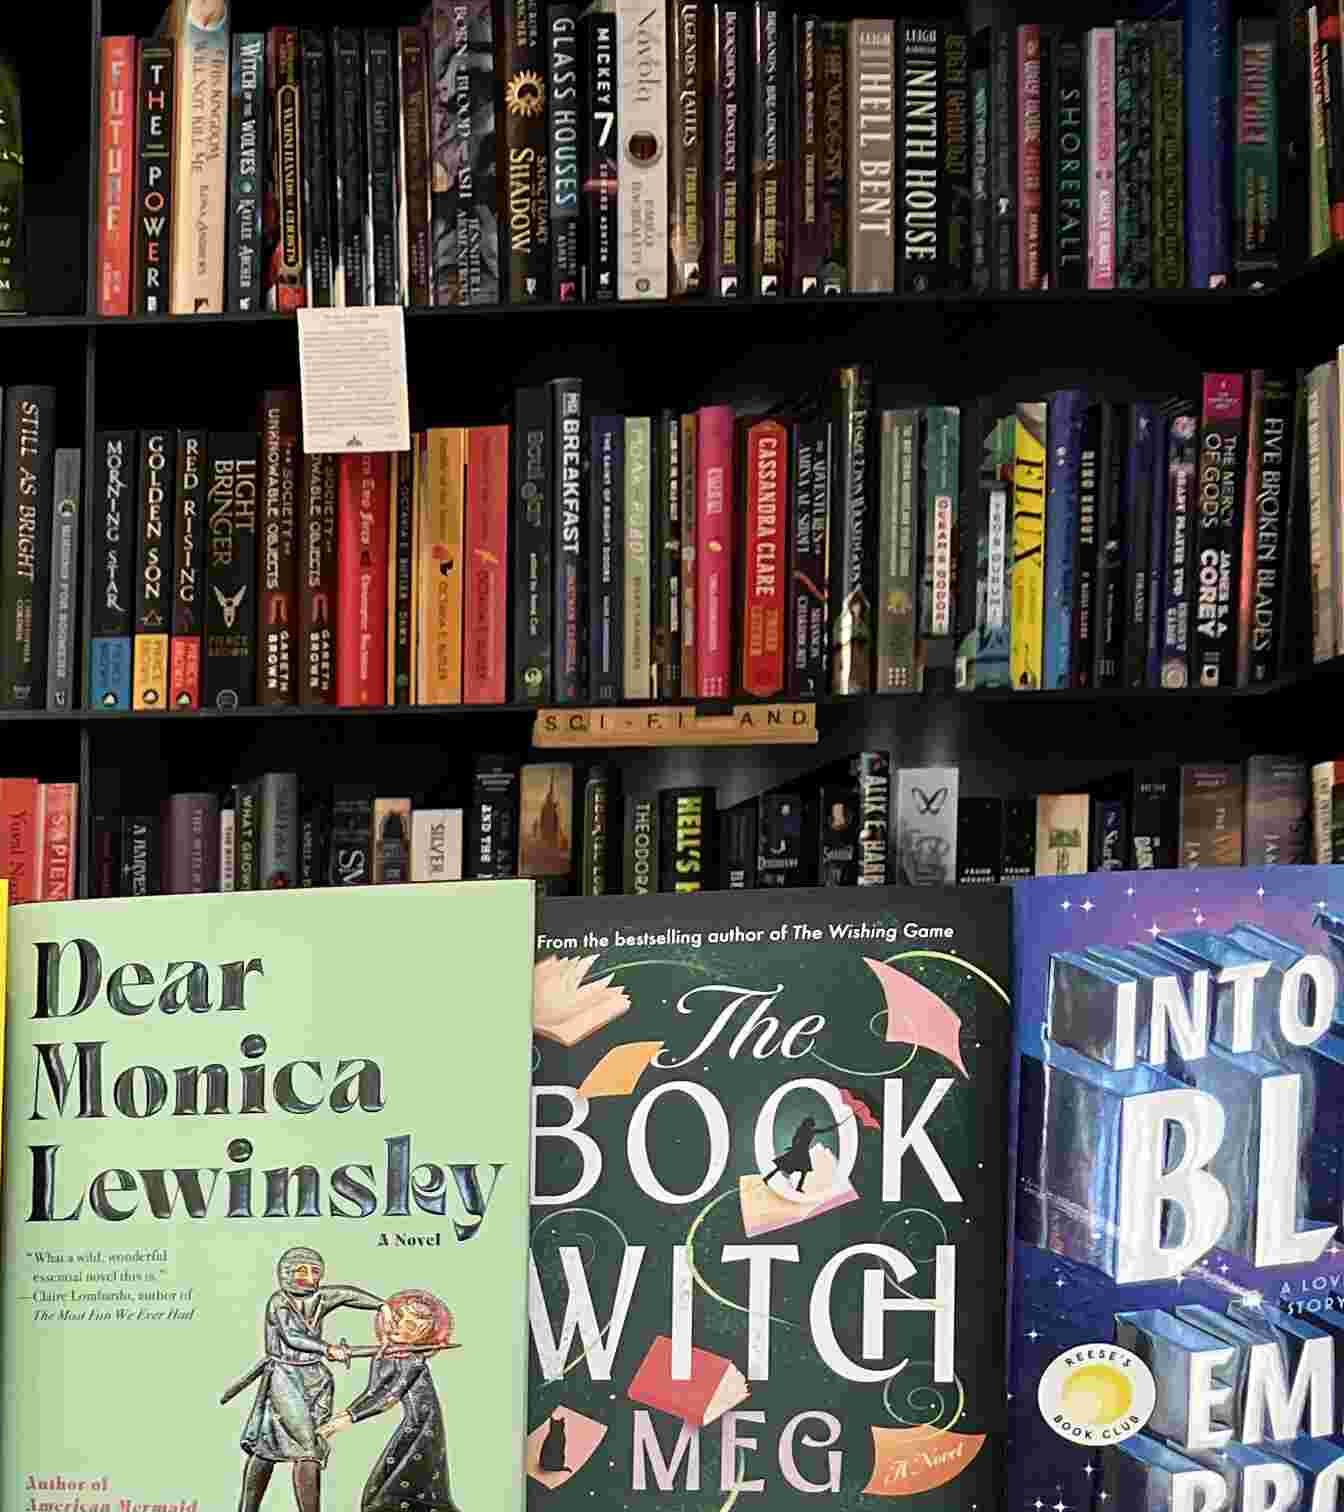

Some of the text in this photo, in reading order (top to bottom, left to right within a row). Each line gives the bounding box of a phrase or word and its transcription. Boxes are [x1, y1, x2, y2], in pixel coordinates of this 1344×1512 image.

[147, 66, 165, 136] THE
[553, 17, 577, 204] GLASS HOUSES
[594, 28, 613, 147] MICKEY 7
[510, 148, 533, 254] SHADOW
[860, 160, 892, 237] BENT
[905, 70, 936, 261] NINTH HOUSE
[1061, 88, 1081, 267] SHOREFALL
[143, 166, 165, 287] POWER
[17, 401, 39, 583] STILL BRIGHT
[106, 439, 127, 613] MORNING STAR
[145, 437, 165, 599] GOLDEN SON
[180, 439, 199, 602] RED RISING
[235, 459, 256, 528] LIGHT
[562, 419, 581, 554] BREAKFAST
[755, 436, 779, 597] CASSANDRA CLARE
[1255, 417, 1285, 652] FIVE BROKEN BLADES
[1198, 550, 1219, 637] COREY
[739, 710, 807, 729] AND
[676, 797, 702, 874] HELL'S
[30, 938, 264, 1020] Dear
[28, 1033, 387, 1121] Monica
[25, 1135, 505, 1241] Lewinsky
